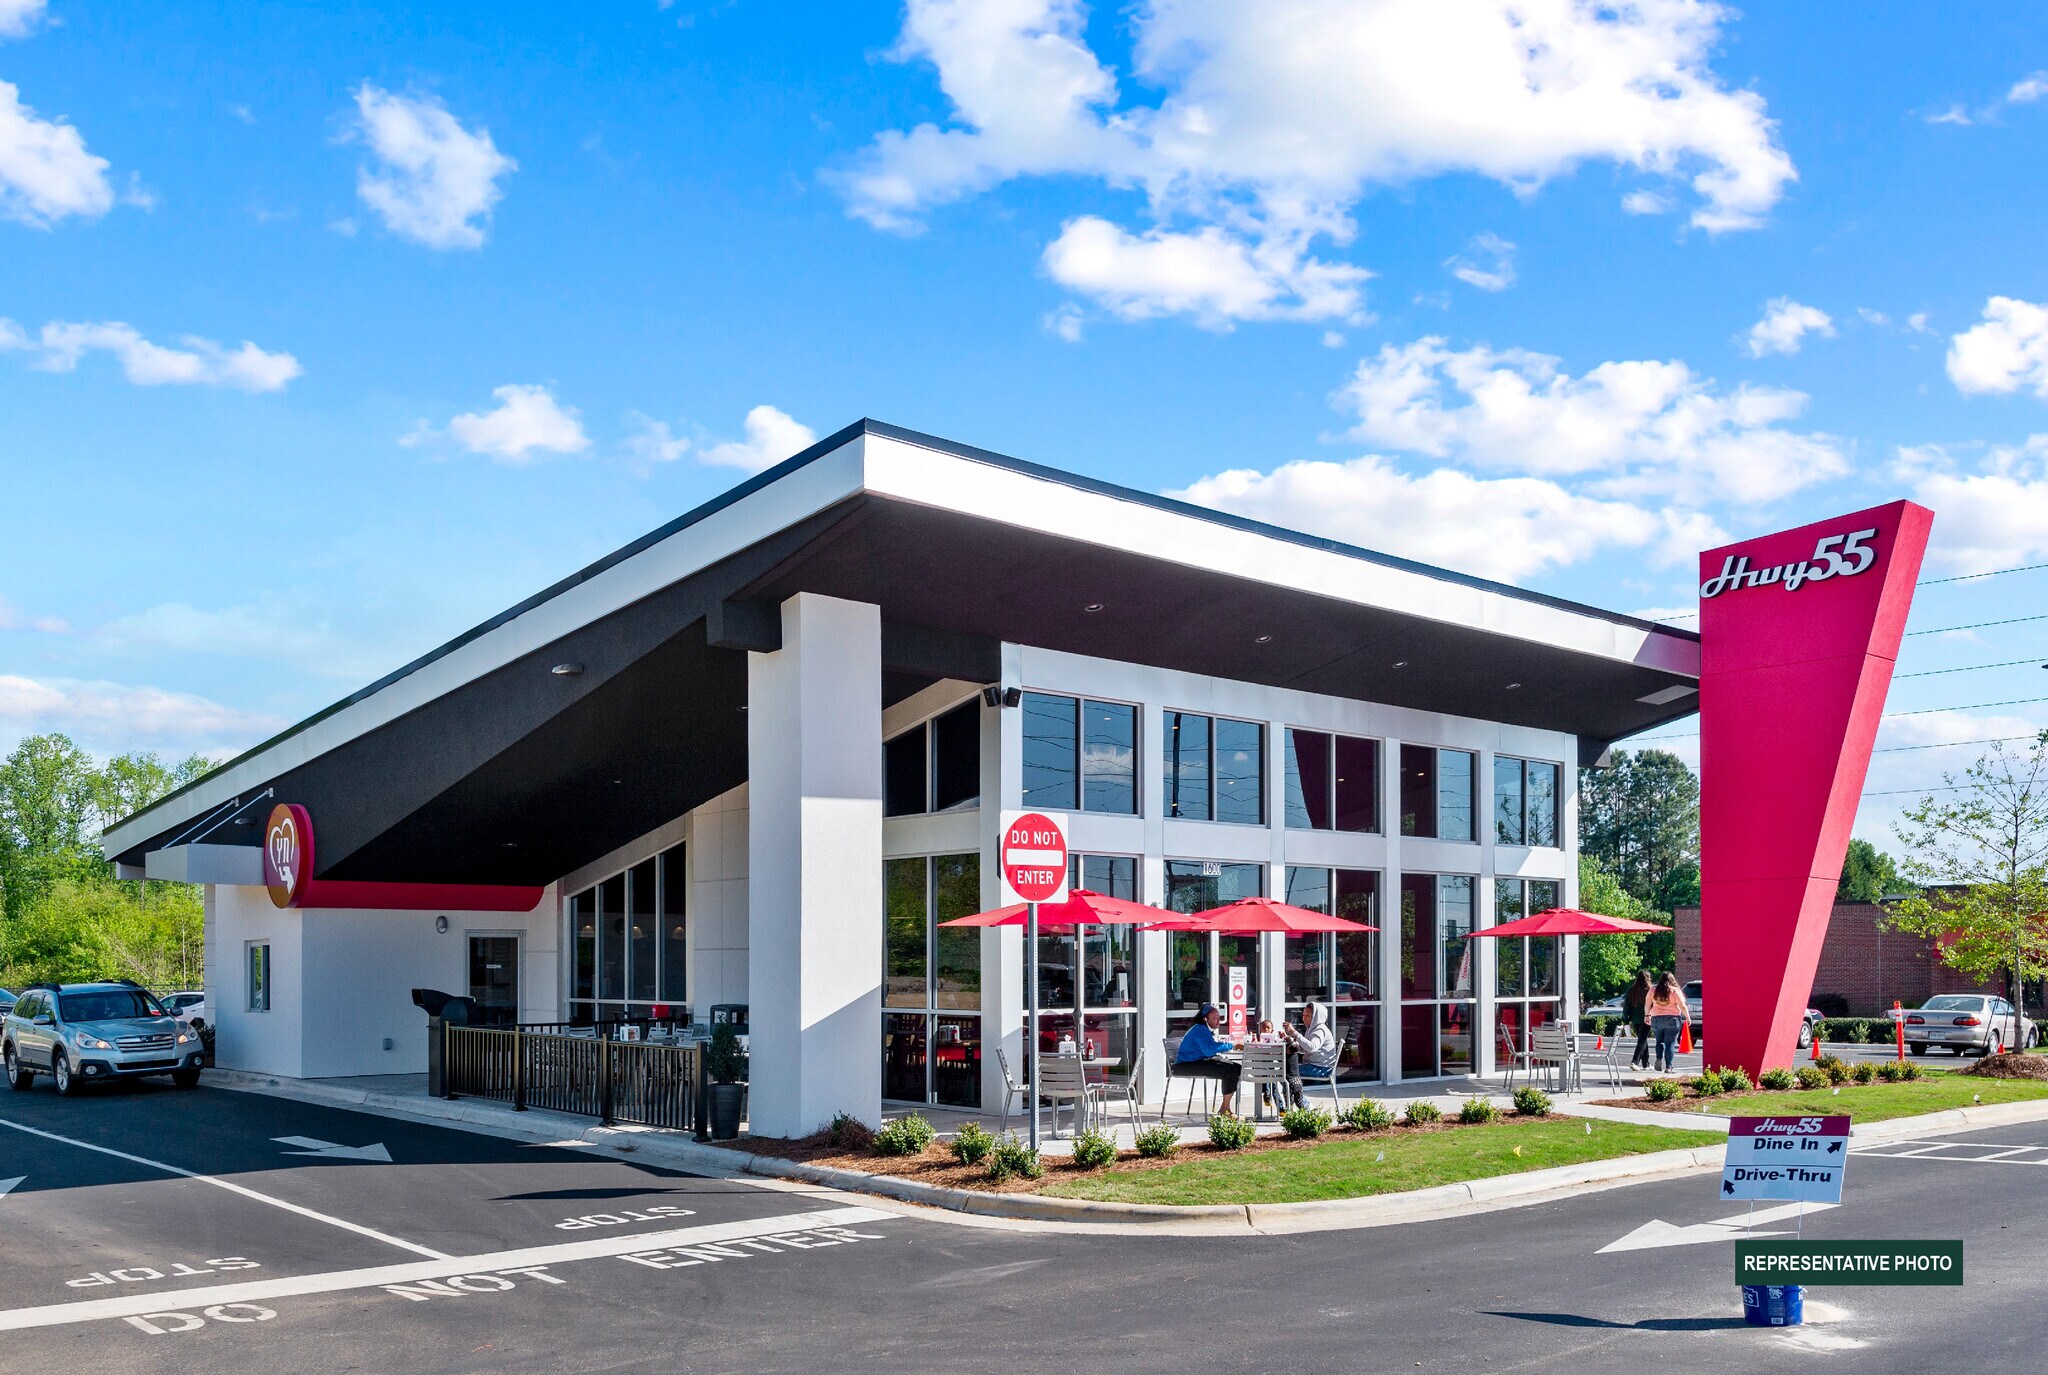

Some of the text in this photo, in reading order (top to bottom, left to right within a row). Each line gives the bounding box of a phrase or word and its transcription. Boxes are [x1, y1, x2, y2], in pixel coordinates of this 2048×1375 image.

[1011, 829, 1058, 846] DO NOT
[1017, 870, 1054, 885] ENTER
[1753, 1137, 1819, 1150] Dine In
[1733, 1168, 1832, 1183] Drive-Thru
[554, 1206, 697, 1230] STOP
[65, 1256, 262, 1288] STOP
[122, 1226, 887, 1335] DO NOT ENTER
